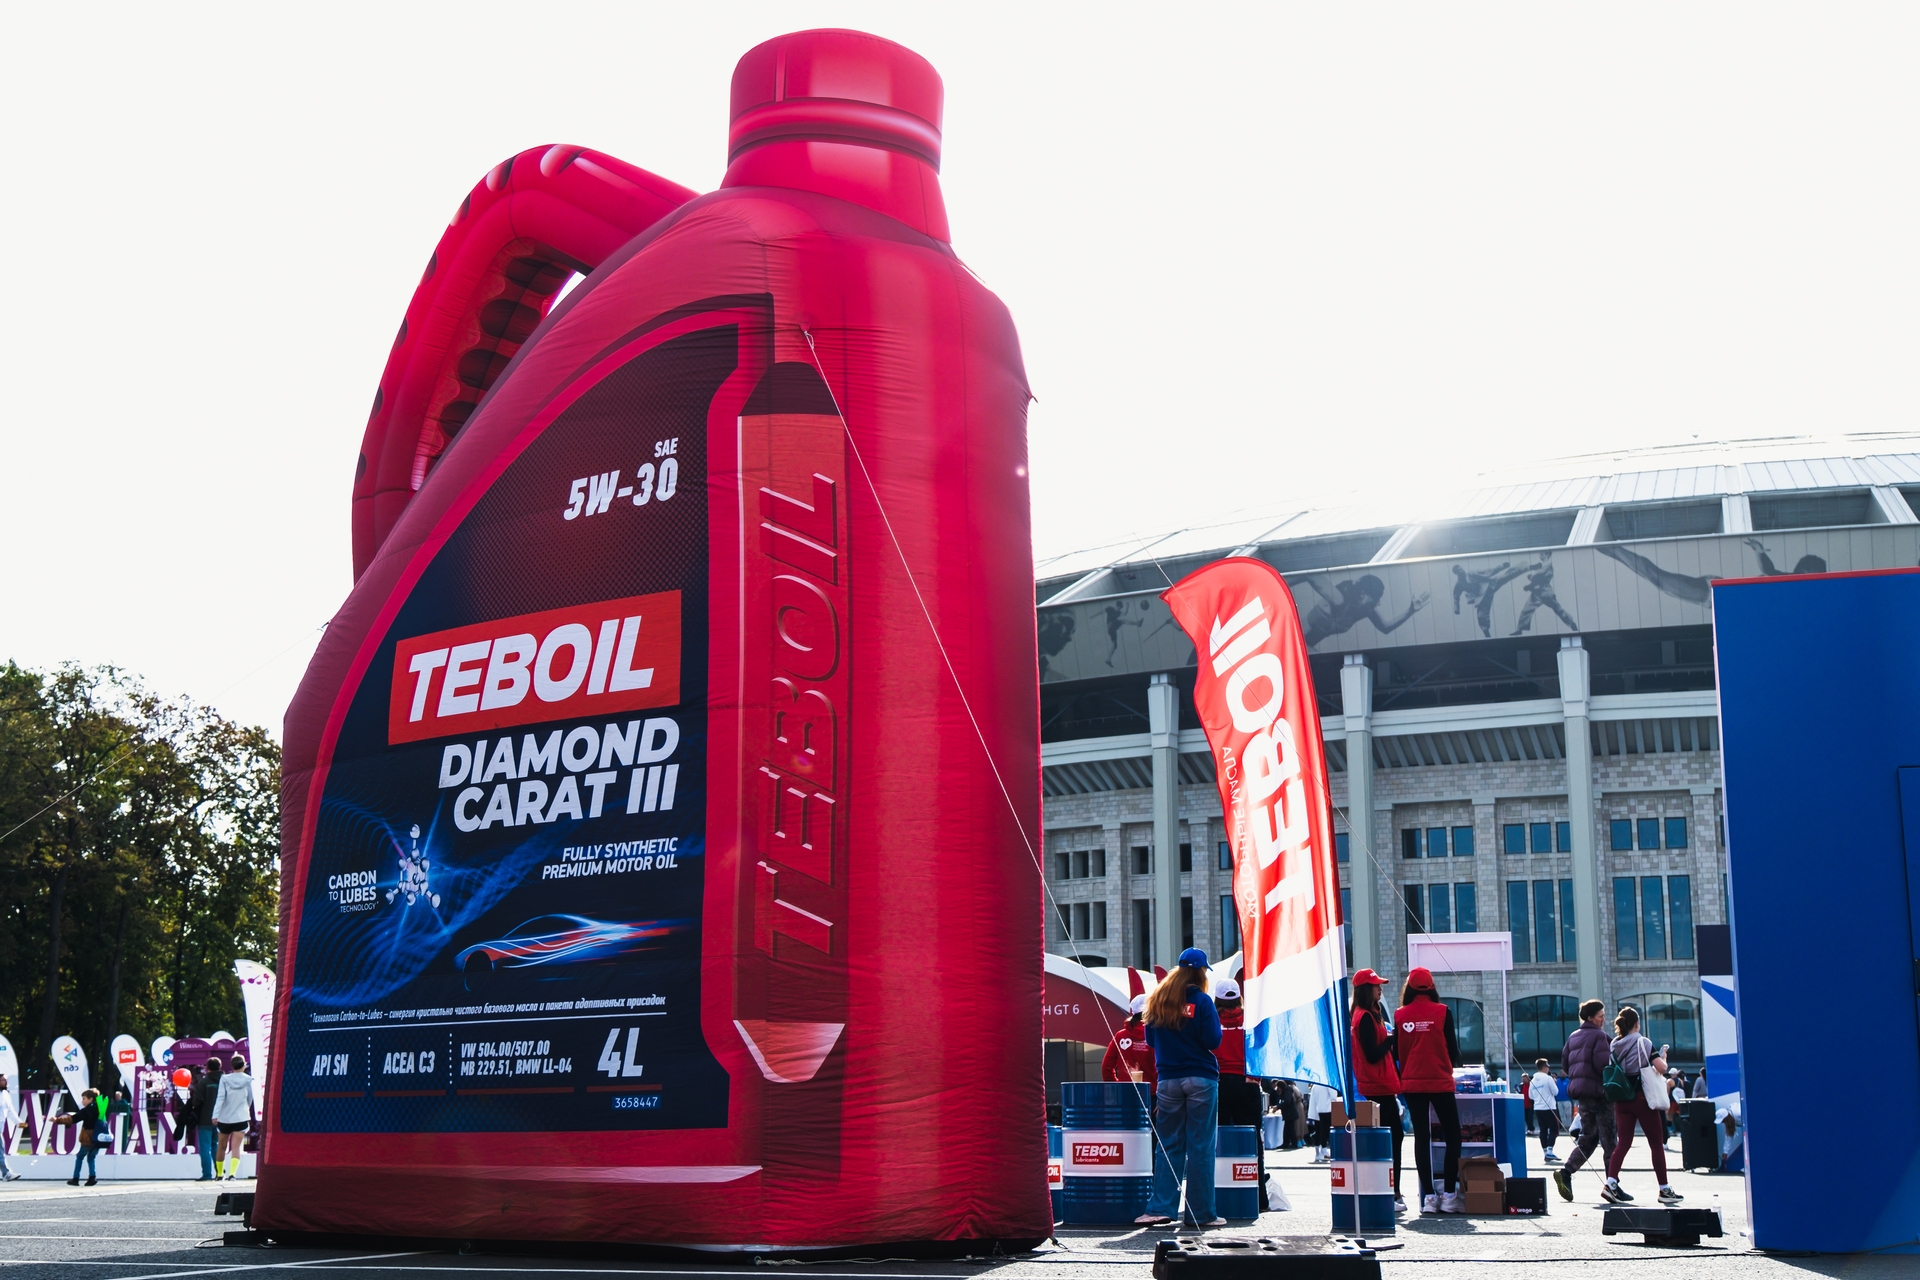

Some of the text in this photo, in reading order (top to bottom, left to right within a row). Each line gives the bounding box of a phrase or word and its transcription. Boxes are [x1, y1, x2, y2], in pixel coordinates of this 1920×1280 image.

[654, 437, 678, 457] SAE
[563, 457, 678, 520] 5W-30
[408, 615, 654, 722] TEBOIL
[754, 472, 838, 958] TEBOIL
[438, 717, 680, 788] DIAMOND
[453, 764, 680, 832] CARAT III
[562, 837, 678, 862] FULLY SYNTHETIC
[542, 854, 678, 880] PREMIUM MOTOR OIL
[328, 869, 377, 890] CARBON
[328, 886, 377, 904] TO LUBES
[515, 1002, 538, 1012] масла
[626, 994, 666, 1009] присадок
[1054, 1004, 1070, 1015] GT
[1072, 1004, 1080, 1015] 6
[461, 1040, 551, 1058] VW 504.00/507.00
[597, 1027, 644, 1078] 4L
[312, 1053, 349, 1076] API SN
[382, 1051, 436, 1075] ACEA C3
[460, 1057, 572, 1077] MB 229.51, BMW LL-04
[615, 1097, 658, 1109] 3658447
[1075, 1145, 1120, 1157] TEBOIL
[1048, 1166, 1060, 1176] OIL
[1235, 1164, 1258, 1175] TEBO
